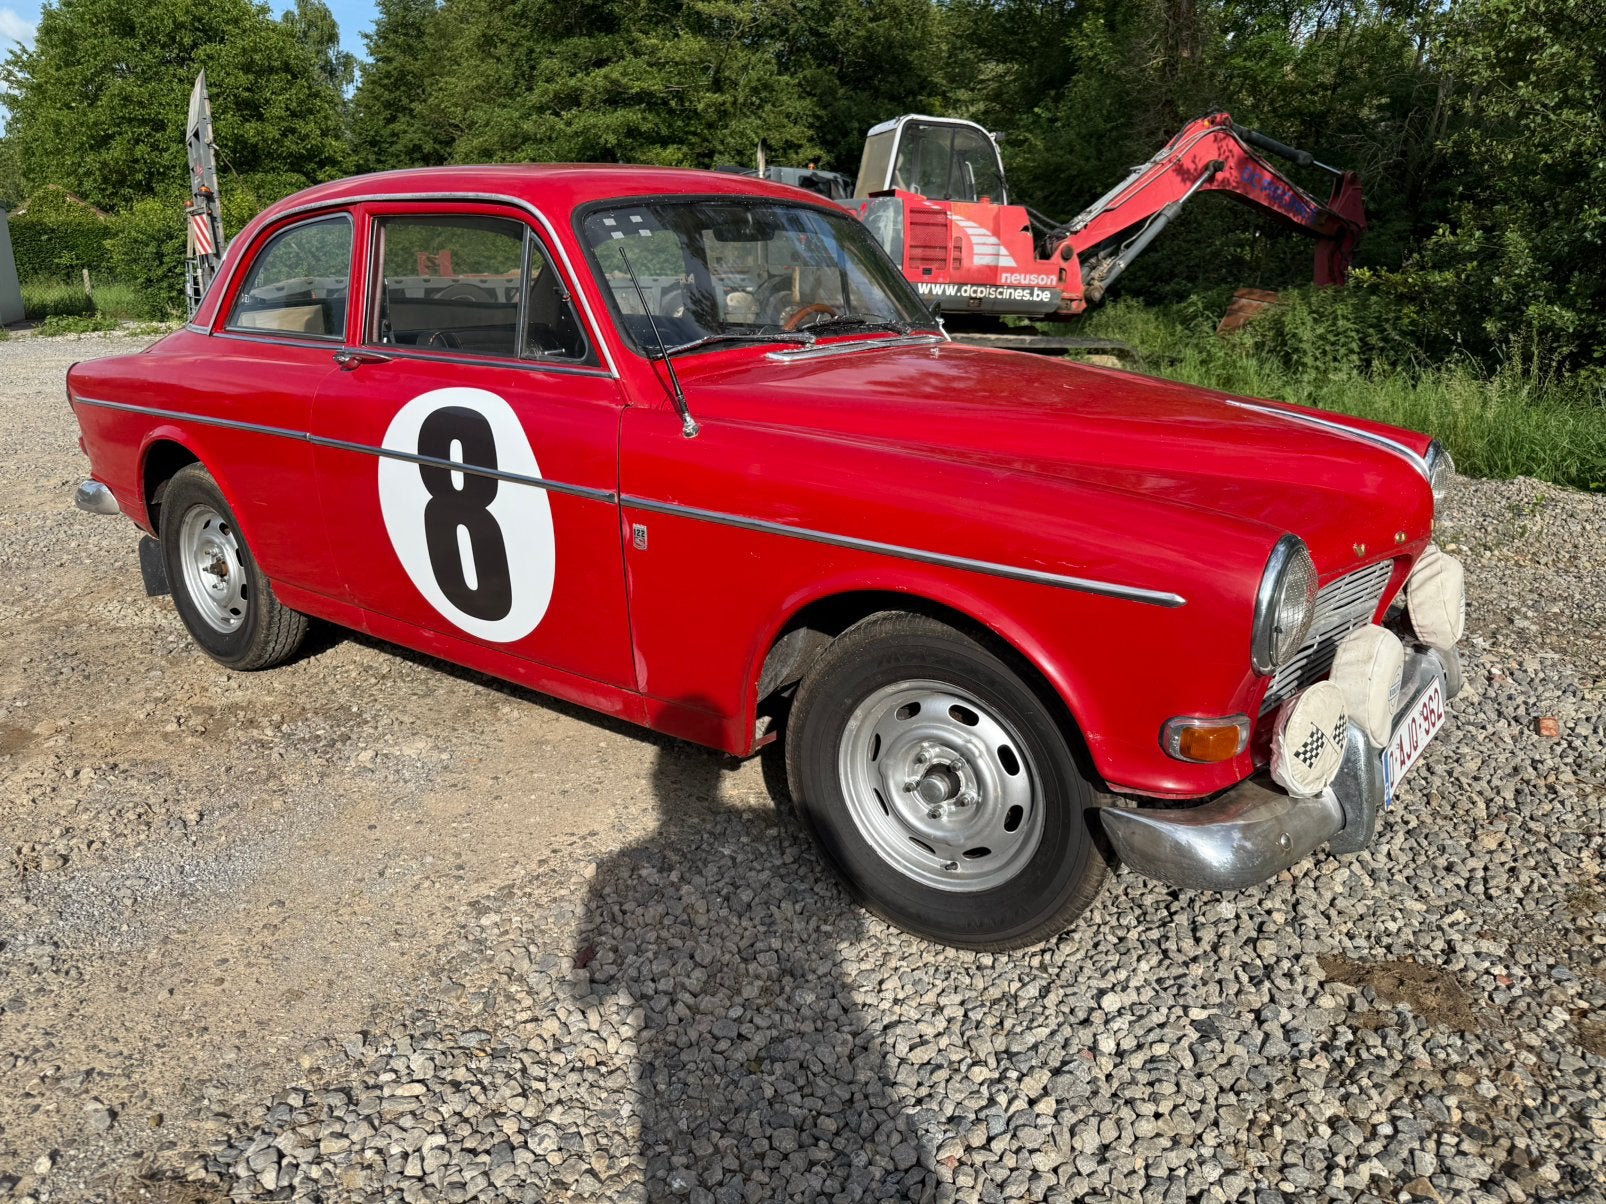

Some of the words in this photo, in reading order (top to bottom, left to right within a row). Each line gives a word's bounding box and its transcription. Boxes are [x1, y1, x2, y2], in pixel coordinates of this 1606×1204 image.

[1001, 272, 1057, 285] neuson
[918, 283, 1051, 301] www.dcpiscines.be
[418, 406, 512, 621] 8
[633, 528, 646, 538] 122
